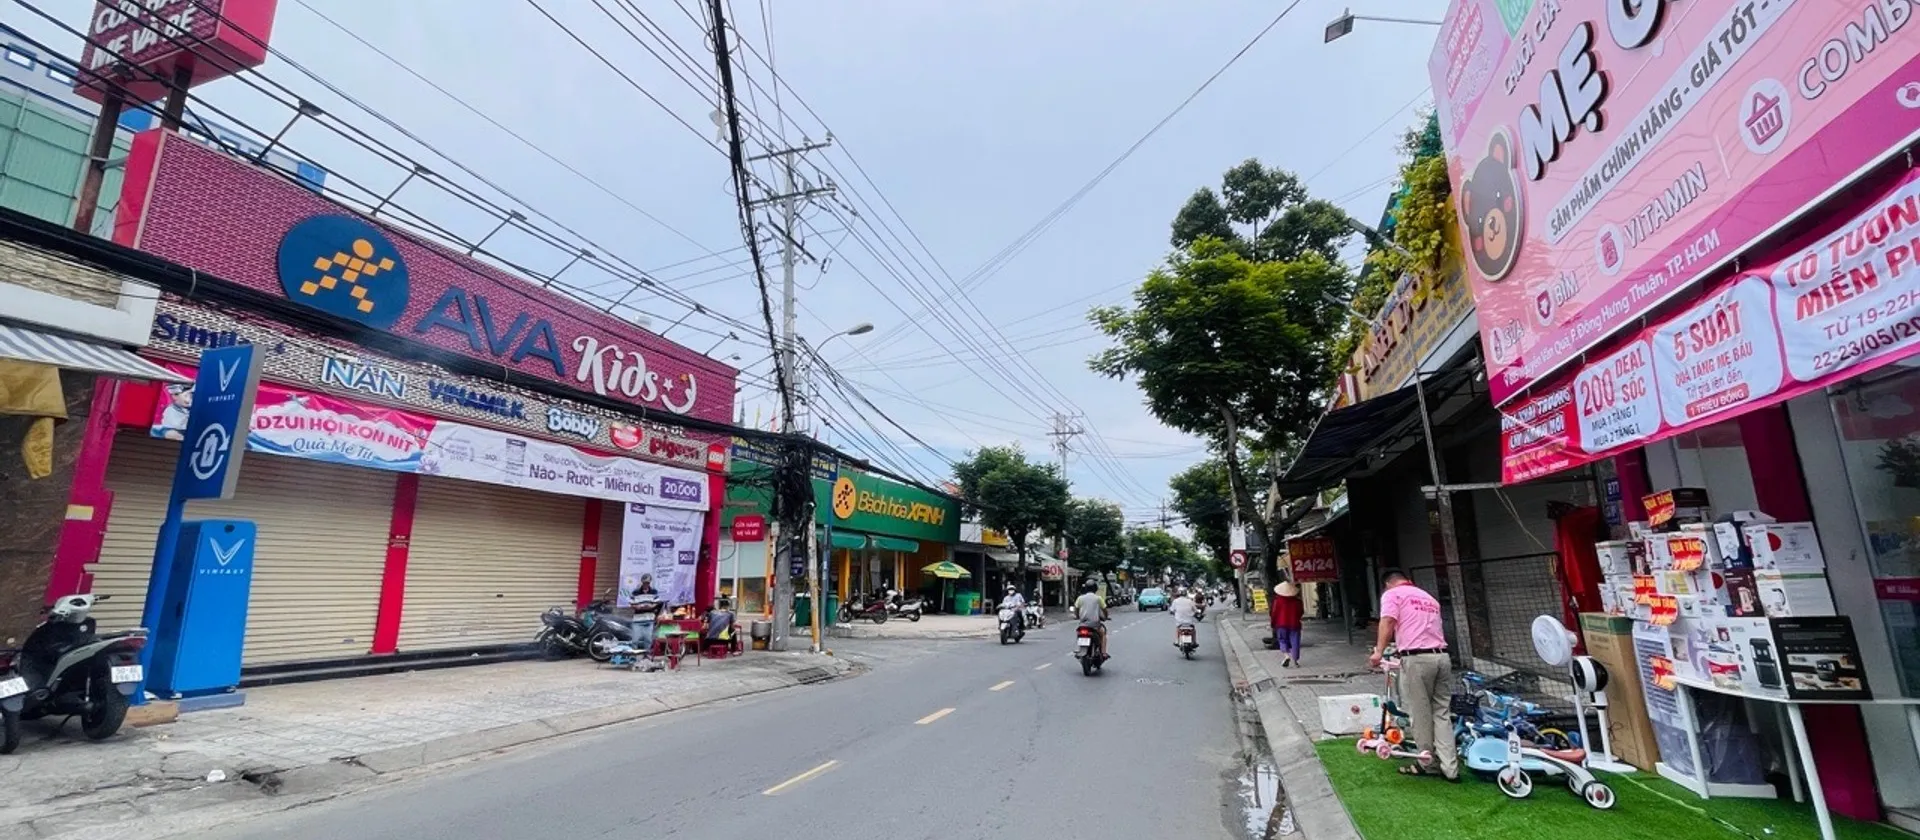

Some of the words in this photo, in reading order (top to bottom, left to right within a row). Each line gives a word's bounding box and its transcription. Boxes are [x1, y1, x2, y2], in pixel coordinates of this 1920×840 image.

[1798, 0, 1920, 100] COMB
[1519, 21, 1608, 180] MẸ
[1551, 209, 1571, 236] SẢN
[1570, 173, 1601, 216] PHẨM
[1601, 132, 1640, 183] CHÍNH
[1640, 87, 1683, 144] HÃNG
[1690, 42, 1721, 88] GIÁ
[1718, 6, 1757, 55] TỐT
[1624, 162, 1708, 248] VITAMIN
[1784, 250, 1818, 288] TÔ
[1828, 195, 1920, 265] TƯỢN
[1601, 297, 1630, 323] Hưng
[1629, 271, 1668, 302] Thuận,
[1665, 254, 1685, 277] TP.
[1684, 228, 1720, 265] HCM
[1796, 261, 1879, 321] MIỄN
[413, 286, 566, 377] AVA
[572, 335, 658, 401] Kids
[1673, 331, 1686, 362] 5
[1688, 296, 1742, 353] SUẤT
[1823, 315, 1851, 341] TỪ
[322, 357, 406, 399] NAN
[1615, 347, 1646, 379] DEAL
[1675, 367, 1691, 387] QUÀ
[1691, 358, 1715, 380] TẶNG
[1717, 351, 1731, 369] MẸ
[1733, 339, 1753, 361] BẦU
[1727, 368, 1743, 384] đến
[1580, 367, 1615, 417] 200
[1621, 372, 1647, 403] SỐC
[1696, 398, 1719, 414] TRIỆU
[1720, 388, 1745, 405] ĐỒNG
[257, 416, 305, 430] DZUI
[346, 425, 384, 443] KON
[547, 408, 600, 440] Bobby
[1592, 416, 1608, 431] MUA
[1612, 408, 1632, 424] TẶNG
[1593, 432, 1609, 447] MUA
[1609, 432, 1614, 443] 2
[1614, 424, 1635, 441] TẶNG
[293, 436, 326, 453] Quà
[858, 490, 886, 514] Bách
[887, 496, 908, 518] hóa
[907, 501, 946, 525] XANH
[1294, 558, 1335, 572] 24/24
